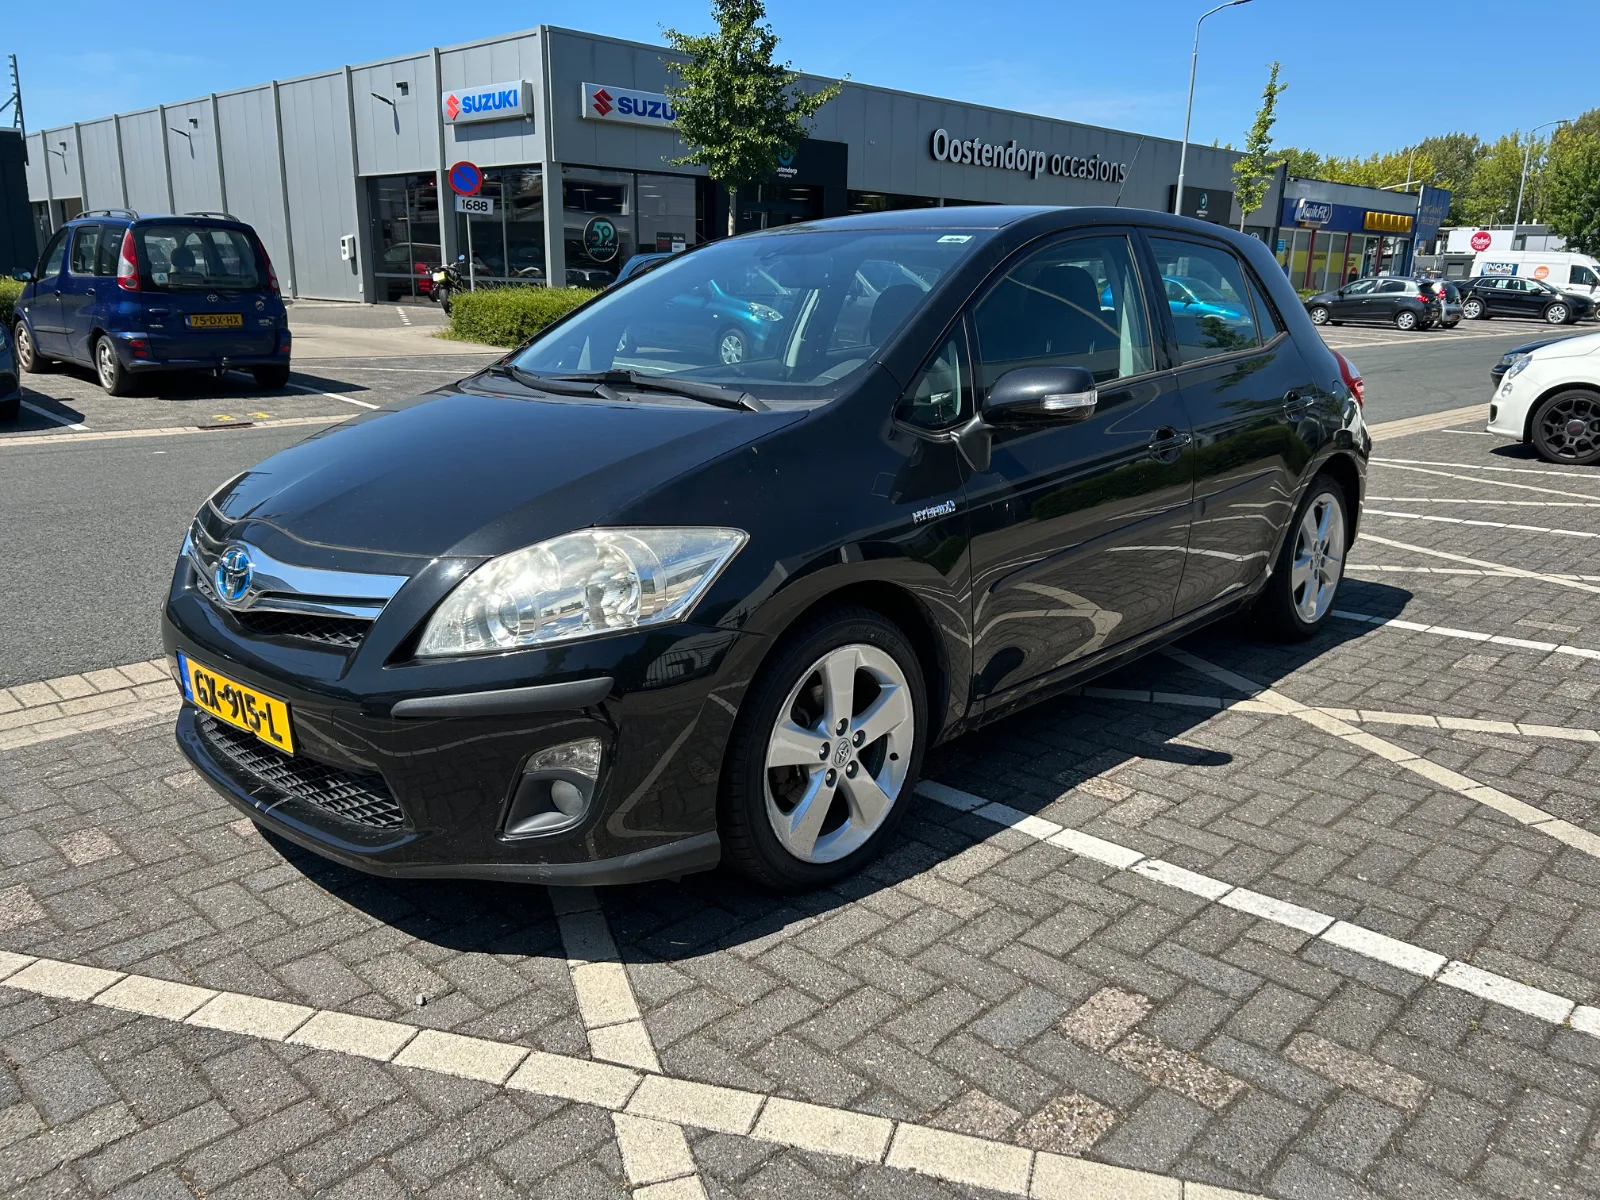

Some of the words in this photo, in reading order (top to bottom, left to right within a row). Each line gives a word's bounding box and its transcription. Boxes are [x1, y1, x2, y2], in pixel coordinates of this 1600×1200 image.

[462, 89, 517, 113] SUZUKI
[618, 96, 680, 121] SUZU
[933, 128, 1047, 180] Oostendorp
[1051, 154, 1127, 183] occasions
[461, 199, 488, 212] 1688
[193, 315, 240, 326] 75-DX-HX
[194, 669, 283, 743] GX-915-L
